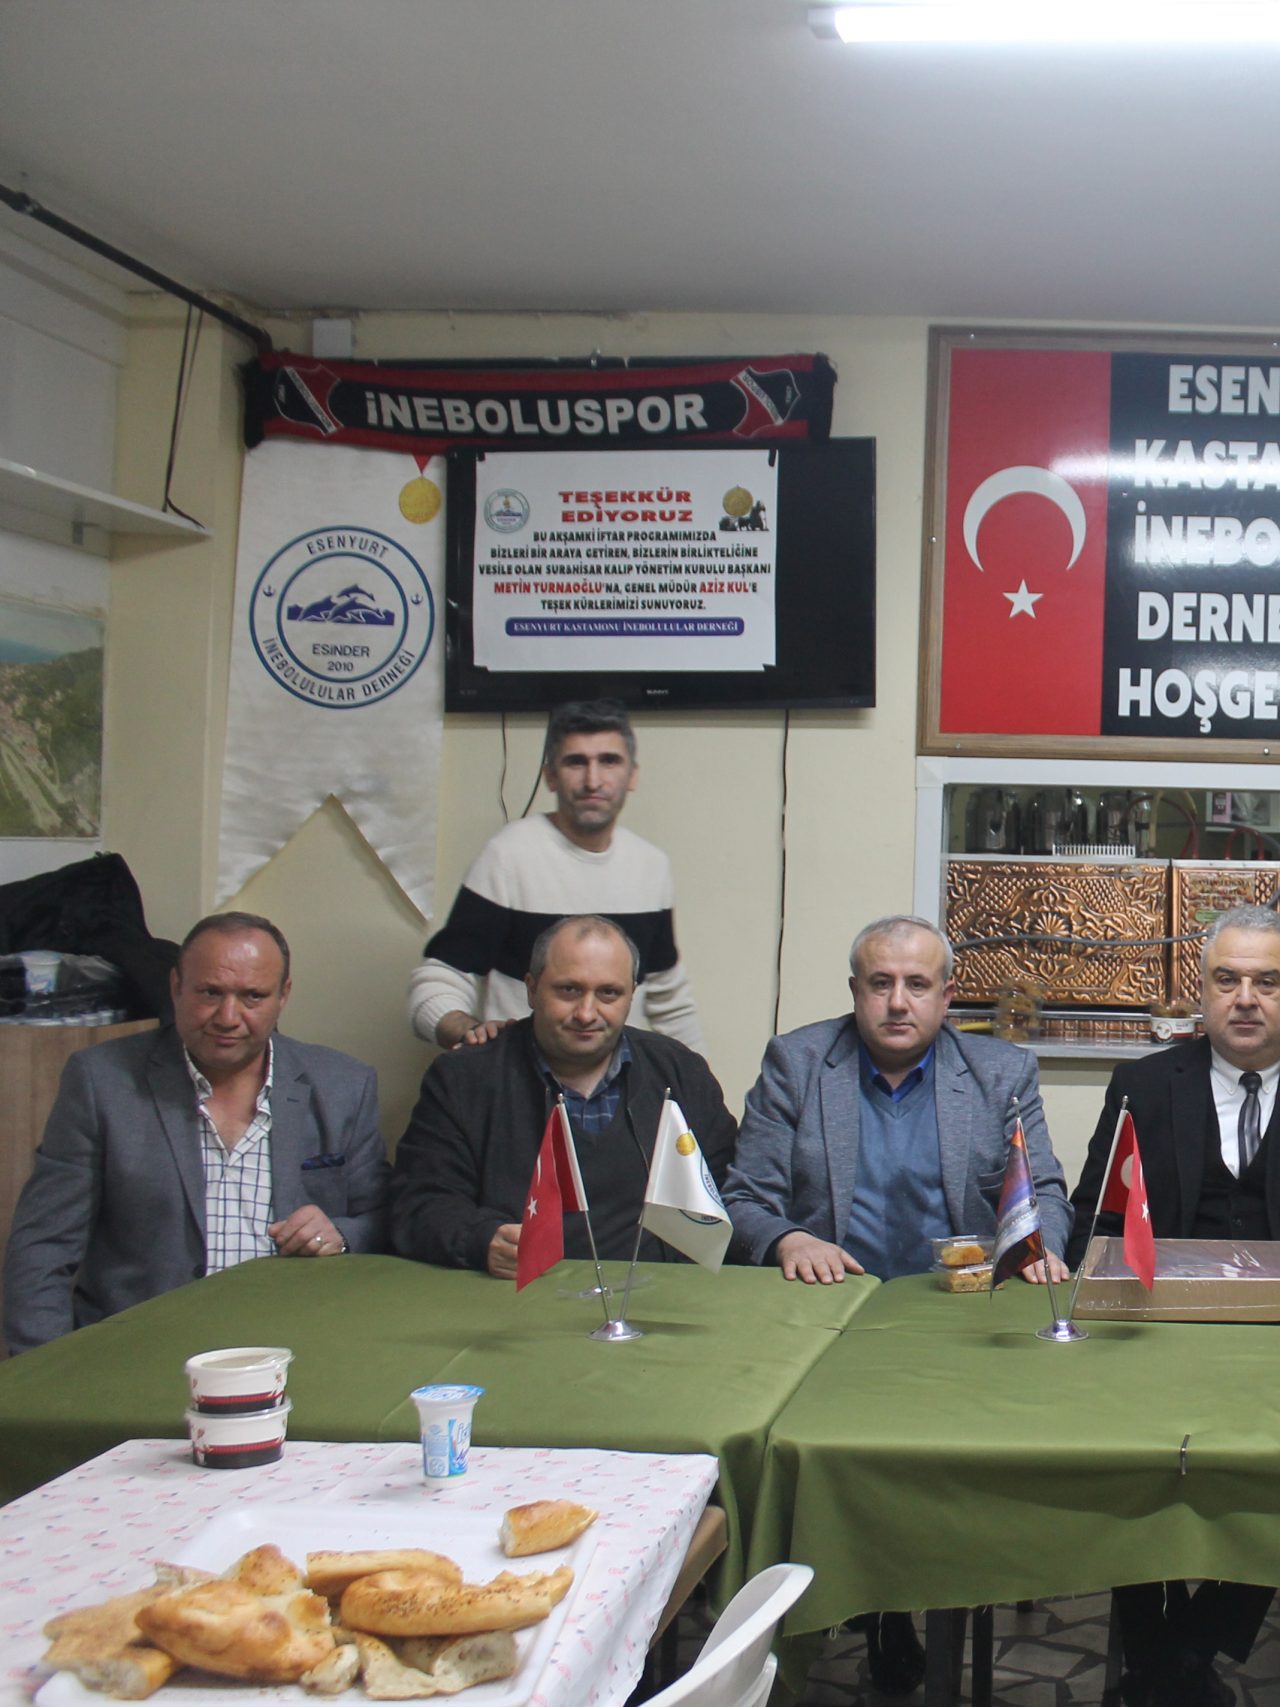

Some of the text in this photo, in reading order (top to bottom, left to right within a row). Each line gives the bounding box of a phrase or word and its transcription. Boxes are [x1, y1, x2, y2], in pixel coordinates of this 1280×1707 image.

[558, 486, 692, 509] TEŞEKKÜR
[561, 507, 694, 522] EDİYORUZ
[533, 528, 717, 545] BU AKŞAMKİ İFTAR PROGRAMIMIZDA
[307, 535, 389, 557] ESENYURT
[490, 543, 759, 559] BİZLERİ BİR ARAYA GETİREN, BİZLERİN BİRLİKTELİĞİNE
[479, 560, 512, 575] VESİLE
[514, 564, 542, 575] OLAN
[604, 564, 633, 575] KALIP
[635, 560, 683, 575] YÖNETİM
[684, 564, 726, 575] KURULU
[727, 563, 771, 578] BAŞKANI
[494, 578, 531, 593] METİN
[624, 583, 656, 593] GENEL
[658, 580, 697, 593] MÜDÜR
[699, 577, 725, 593] AZİZ
[727, 582, 758, 593] KUL'E
[541, 596, 706, 614] TEŞEK KÜRLERİMİZİ SUNUYORUZ.
[514, 622, 561, 632] ESENYURT
[563, 622, 620, 632] KASTAMONU
[696, 622, 739, 632] DERNEĞİ
[263, 637, 415, 700] İNEBOLULULAR DERNEĞİ
[327, 661, 354, 671] 2010
